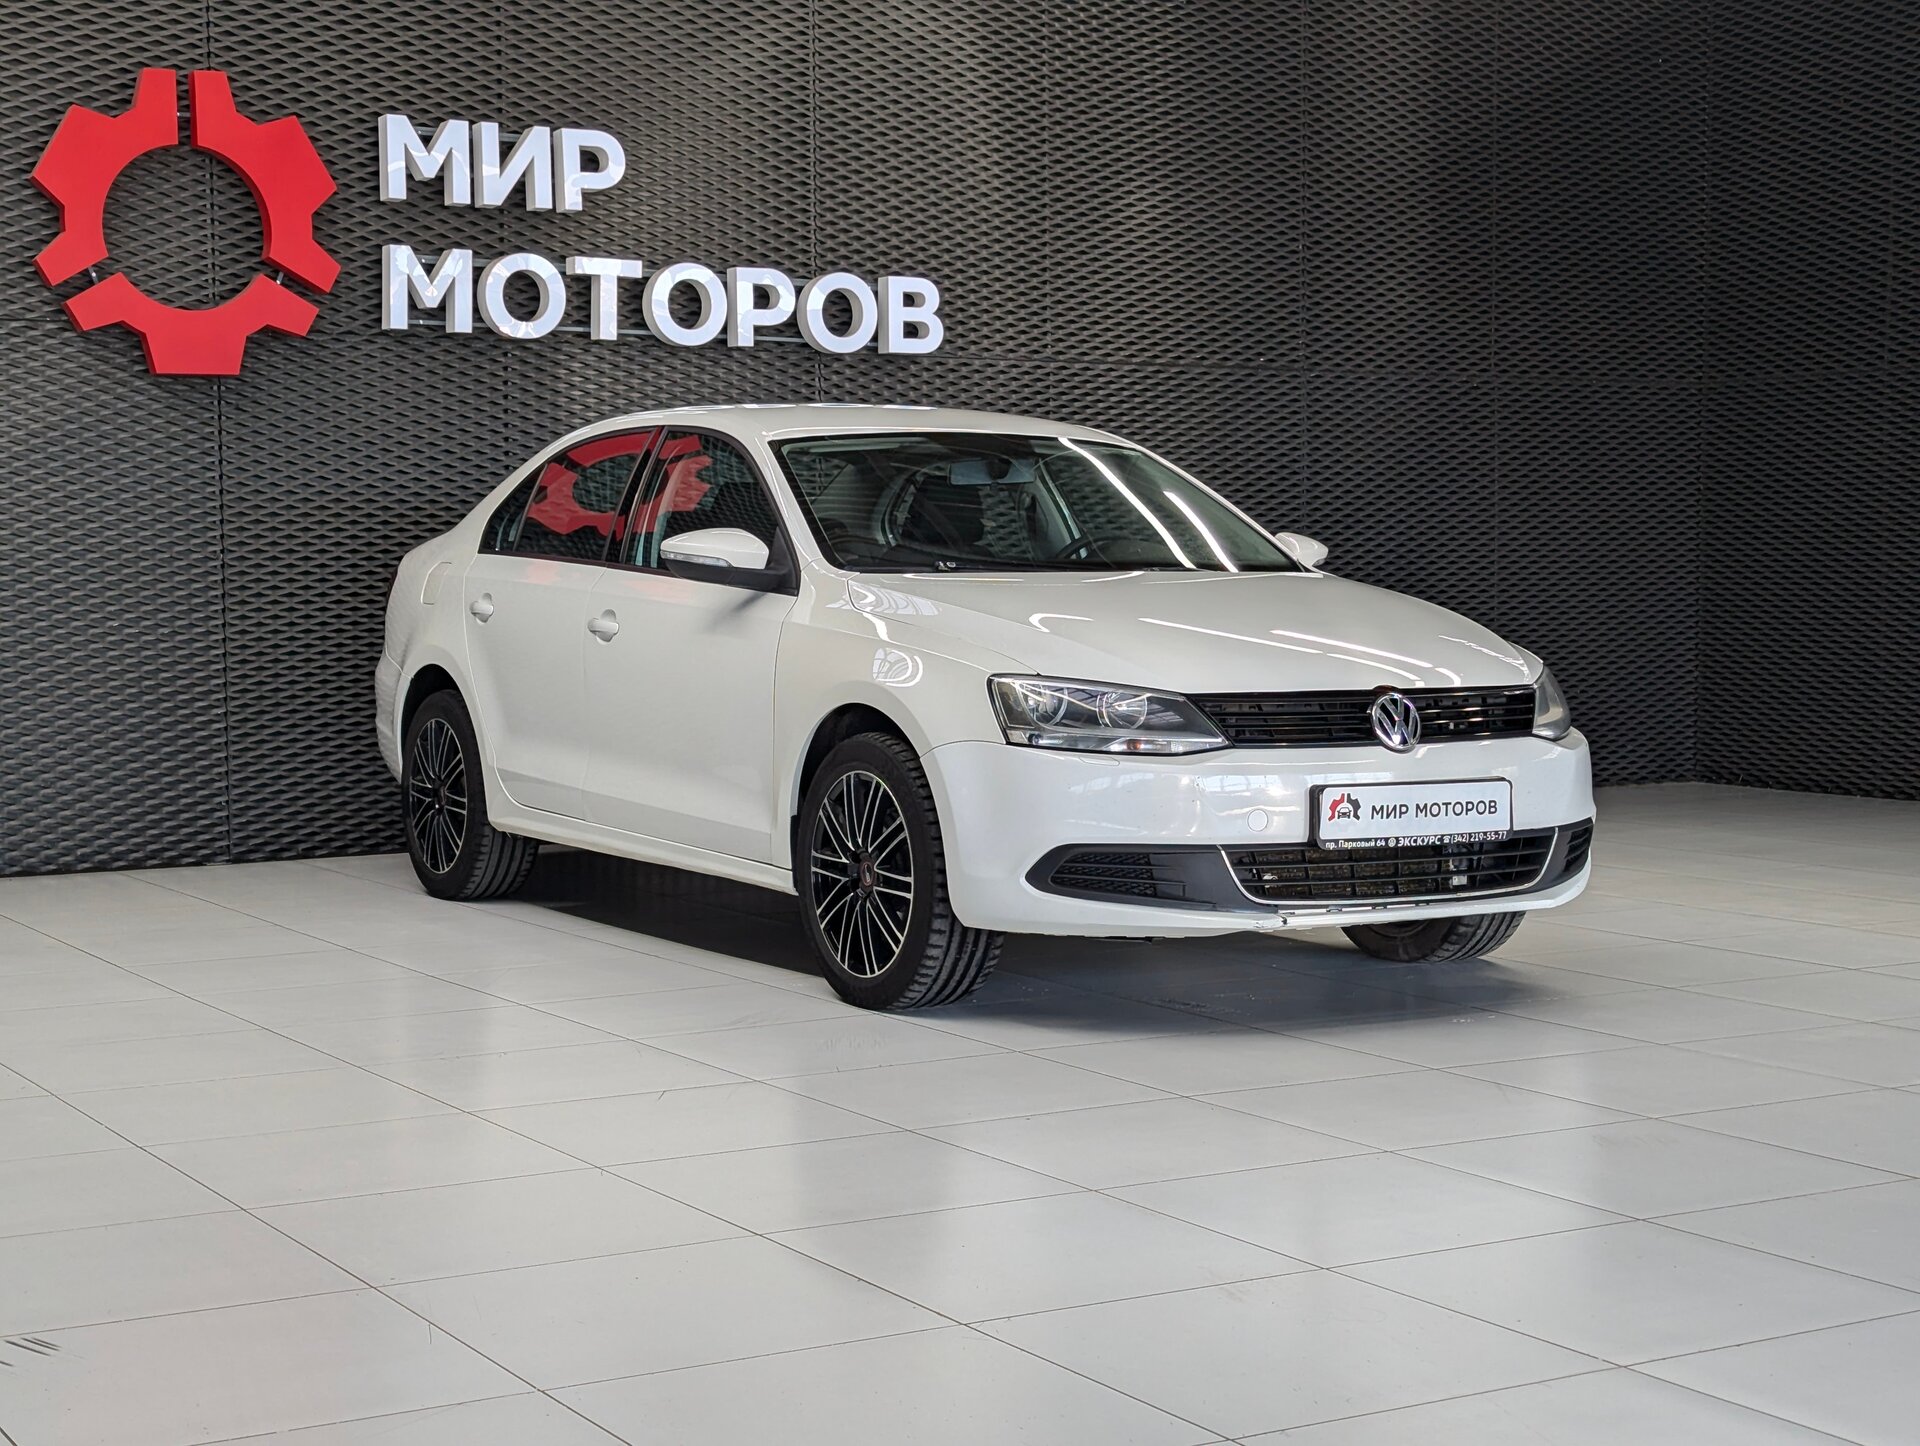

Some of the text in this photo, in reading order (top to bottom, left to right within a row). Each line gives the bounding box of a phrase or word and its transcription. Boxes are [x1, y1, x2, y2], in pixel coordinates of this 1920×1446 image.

[378, 113, 626, 213] МИР
[381, 244, 944, 355] МОТОРОВ
[1371, 800, 1498, 820] МИР МОТОРОВ
[1325, 831, 1507, 850] пр. Парковый 64 ЭКСКУРС (342) 219-55-77
